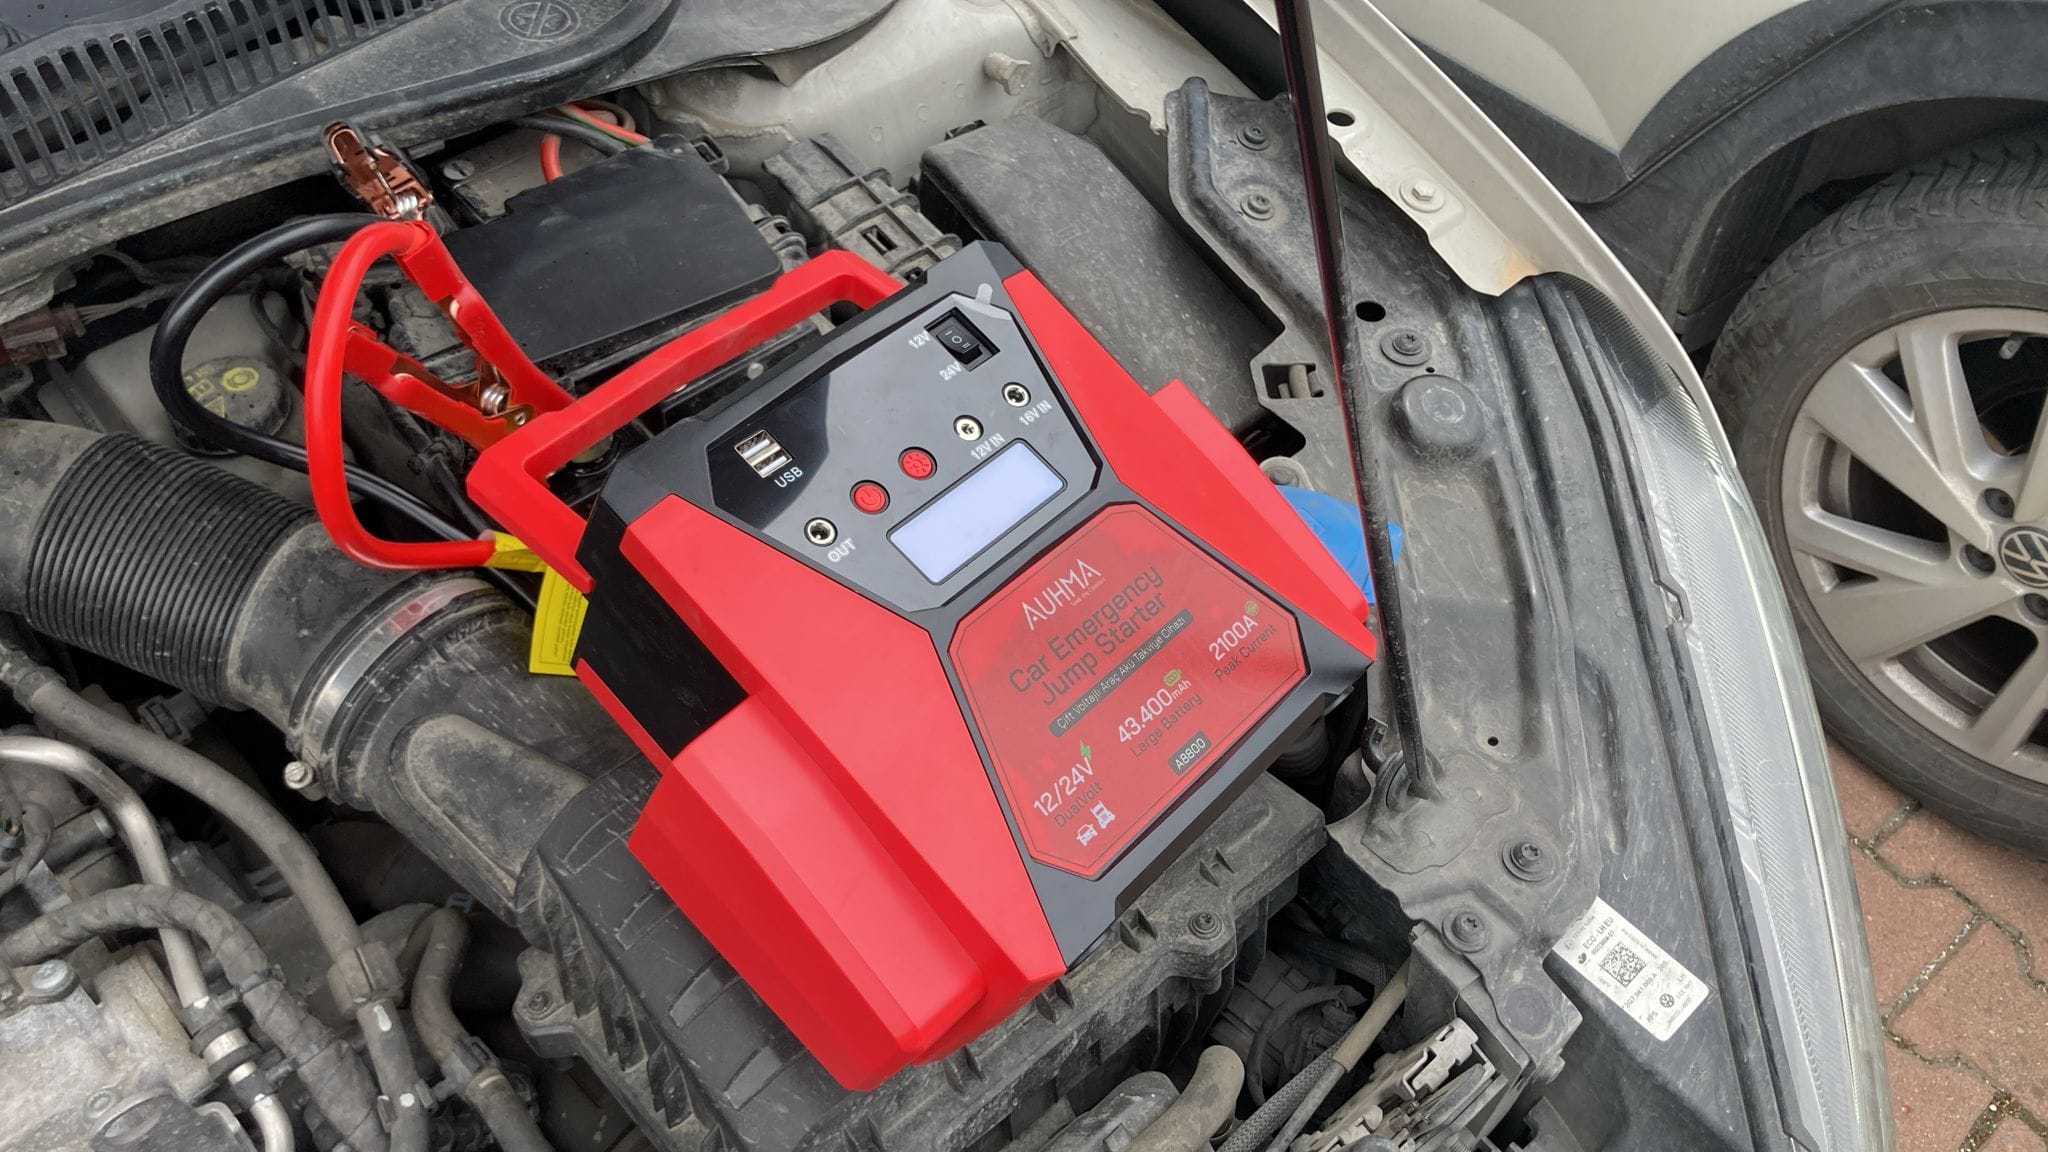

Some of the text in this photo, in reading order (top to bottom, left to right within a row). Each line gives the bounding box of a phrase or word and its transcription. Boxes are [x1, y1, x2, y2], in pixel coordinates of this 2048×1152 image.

[908, 330, 931, 349] 12V
[939, 361, 962, 381] 24V
[1019, 400, 1053, 426] 16V IN
[970, 433, 1006, 460] 12V IN
[774, 466, 803, 488] USB
[828, 538, 856, 562] OUT
[1021, 559, 1102, 631] AUHMA
[1008, 566, 1164, 693] Car Emergency
[1042, 592, 1166, 705] Jump Starter
[1209, 615, 1259, 661] 2100A
[1100, 674, 1121, 692] Araç
[1133, 635, 1163, 662] Takviye
[1214, 624, 1277, 679] Peak Current
[1130, 694, 1203, 757] Large Battery
[1175, 737, 1206, 770] A8800
[1034, 756, 1093, 816] 12/24V
[1583, 935, 1596, 949] ECO
